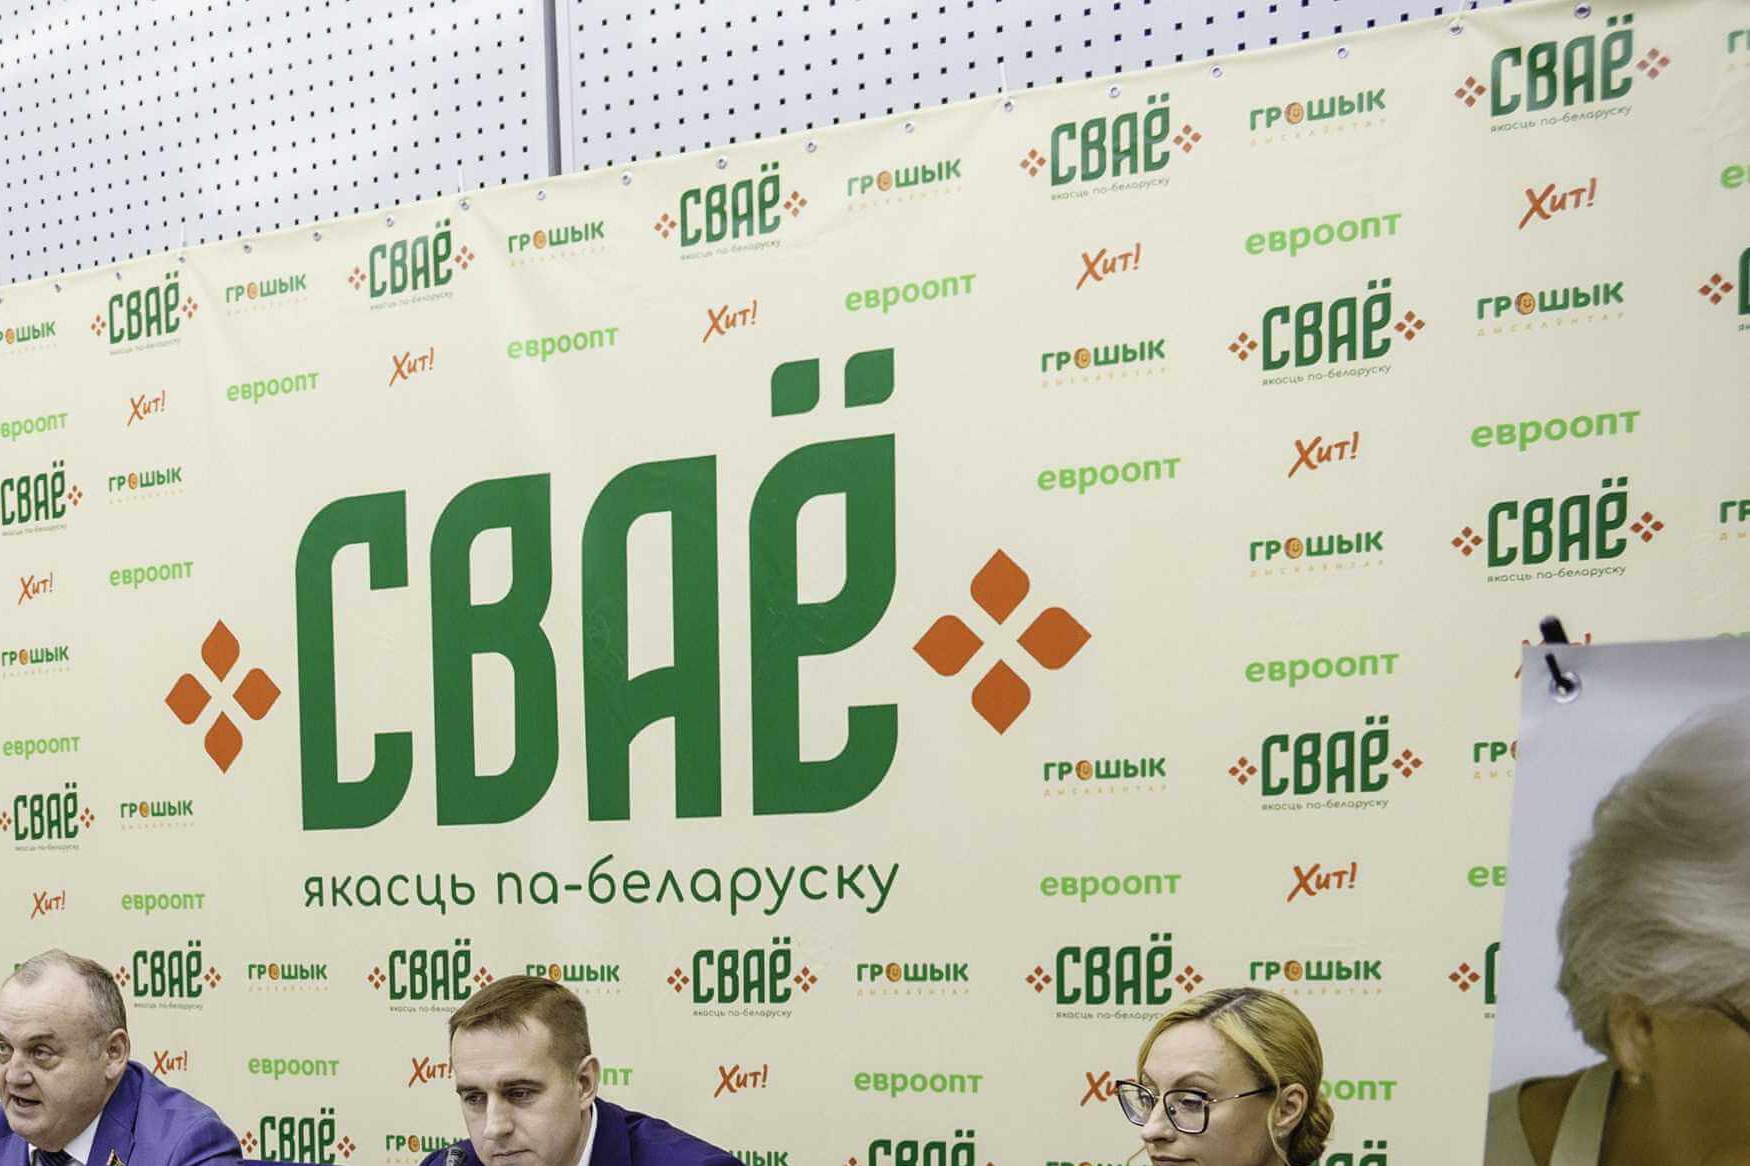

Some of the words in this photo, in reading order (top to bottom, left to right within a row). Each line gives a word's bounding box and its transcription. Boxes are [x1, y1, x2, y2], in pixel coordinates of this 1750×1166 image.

[1490, 11, 1635, 120] СВАЁ
[1249, 87, 1386, 132] ГРОШЫК
[1050, 91, 1171, 188] СВАЁ
[847, 157, 962, 197] ГРОШЫК
[679, 160, 781, 248] СВАЁ
[1517, 175, 1598, 231] Хит!
[507, 220, 605, 254] ГРОШЫК
[1242, 211, 1403, 257] евроопт
[369, 217, 453, 299] СВАЁ
[1075, 241, 1143, 291] Хит!
[108, 269, 181, 345] СВАЁ
[225, 273, 307, 304] ГРОШЫК
[845, 272, 974, 315] евроопт
[1476, 280, 1625, 321] ГРОШЫК
[701, 299, 758, 344] Хит!
[1261, 276, 1393, 375] СВАЁ
[505, 326, 618, 362] евроопт
[1041, 337, 1166, 374] ГРОШЫК
[225, 368, 319, 402] евроопт
[388, 346, 436, 388] Хит!
[126, 389, 166, 428] Хит!
[1468, 409, 1643, 455] евроопт
[1287, 430, 1360, 479] Хит!
[0, 459, 67, 527] СВАЁ
[108, 466, 183, 493] ГРОШЫК
[1035, 457, 1180, 497] евроопт
[1487, 475, 1629, 569] СВАЁ
[1249, 530, 1384, 563] ГРОШЫК
[17, 571, 54, 606] Хит!
[107, 559, 193, 590] евроопт
[300, 347, 897, 831] СВАЁ
[1, 644, 70, 668] ГРОШЫК
[1242, 652, 1403, 689] евроопт
[1, 735, 80, 761] евроопт
[1260, 714, 1390, 797] СВАЁ
[1043, 756, 1167, 783] ГРОШЫК
[13, 781, 80, 841] СВАЁ
[119, 799, 194, 819] ГРОШЫК
[121, 891, 203, 913] евроопт
[304, 872, 476, 916] якасць
[496, 853, 900, 917] па-беларуску
[1039, 872, 1180, 904] евроопт
[1285, 860, 1359, 905] Хит!
[30, 889, 66, 921] Хит!
[132, 939, 203, 999] СВАЁ
[247, 962, 328, 981] ГРОШЫК
[389, 938, 472, 1001] СВАЁ
[526, 962, 620, 982] ГРОШЫК
[692, 935, 793, 1005] СВАЁ
[856, 961, 970, 983] ГРОШЫК
[1055, 931, 1173, 1006] СВАЁ
[1249, 959, 1383, 982] ГРОШЫК
[153, 1051, 188, 1074] Хит!
[248, 1056, 340, 1079] евроопт
[409, 1057, 453, 1087] Хит!
[713, 1063, 770, 1099] Хит!
[851, 1071, 984, 1098] евроопт
[259, 1108, 336, 1164] СВАЁ
